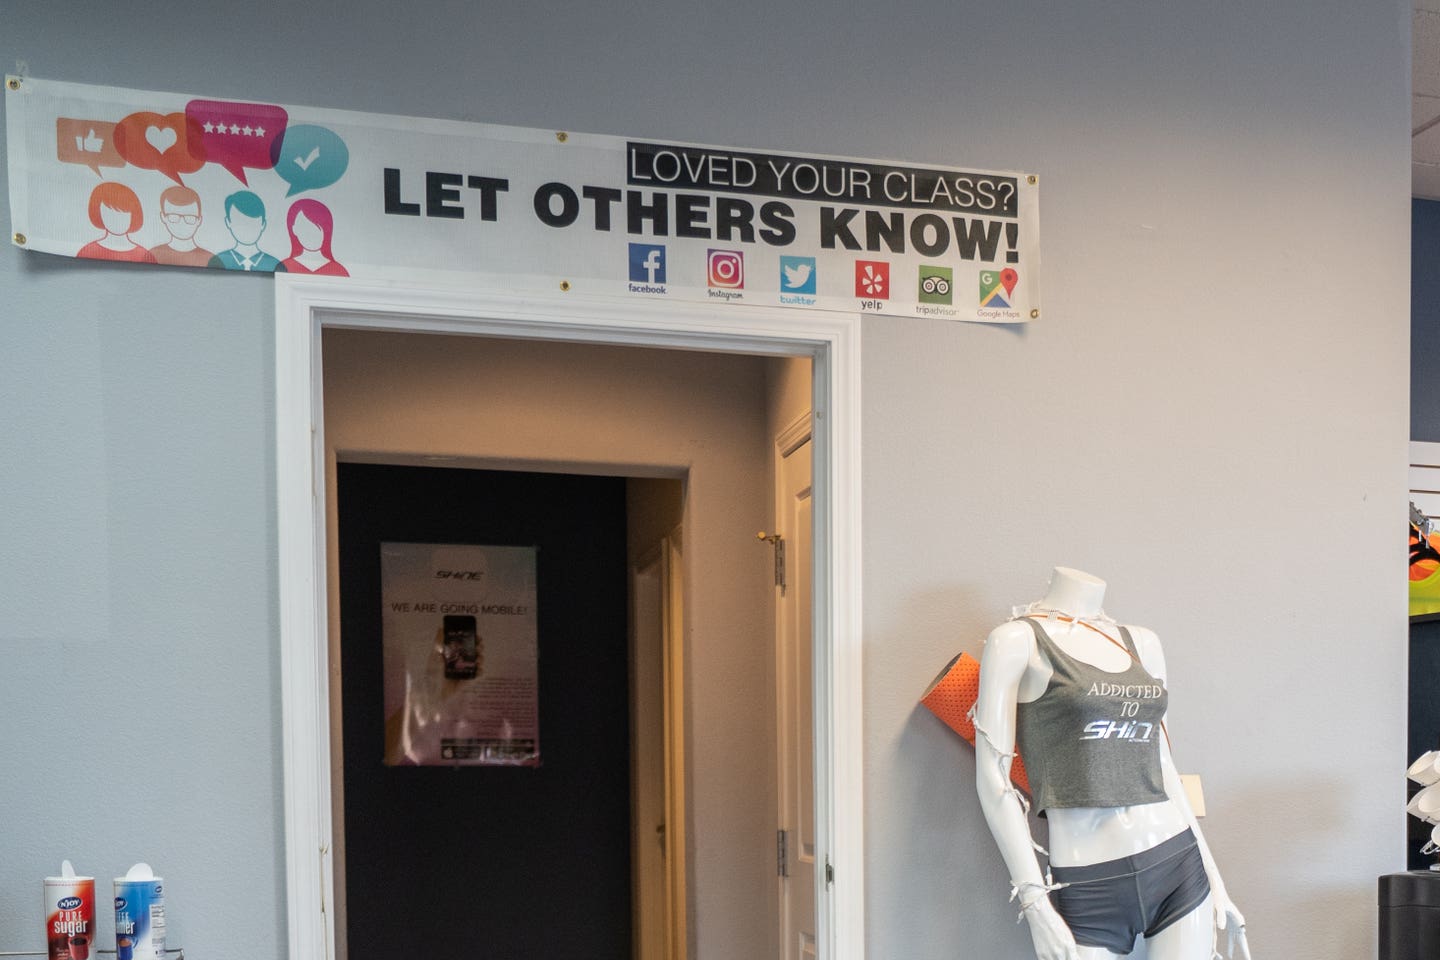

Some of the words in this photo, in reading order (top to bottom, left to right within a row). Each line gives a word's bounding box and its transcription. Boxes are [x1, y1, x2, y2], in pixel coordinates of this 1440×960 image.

[631, 148, 756, 183] LOVED
[769, 160, 872, 199] YOUR
[884, 172, 1015, 211] CLASS?
[384, 168, 509, 221] LET
[532, 182, 797, 247] OTHERS
[819, 206, 1019, 263] KNOW!
[628, 283, 667, 295] facebook
[707, 289, 743, 301] Instagram
[780, 296, 816, 306] twitter
[861, 299, 882, 310] yelp
[916, 306, 958, 316] tripadvisor
[977, 309, 1000, 318] Google
[1002, 311, 1020, 319] Maps
[392, 603, 410, 613] WE
[414, 603, 436, 613] ARE
[440, 604, 478, 615] GOING
[482, 605, 528, 616] MOBILE!
[1087, 682, 1162, 699] ADDICTED
[1120, 701, 1140, 717] TO
[59, 911, 82, 921] PURE
[54, 920, 88, 937] sugar
